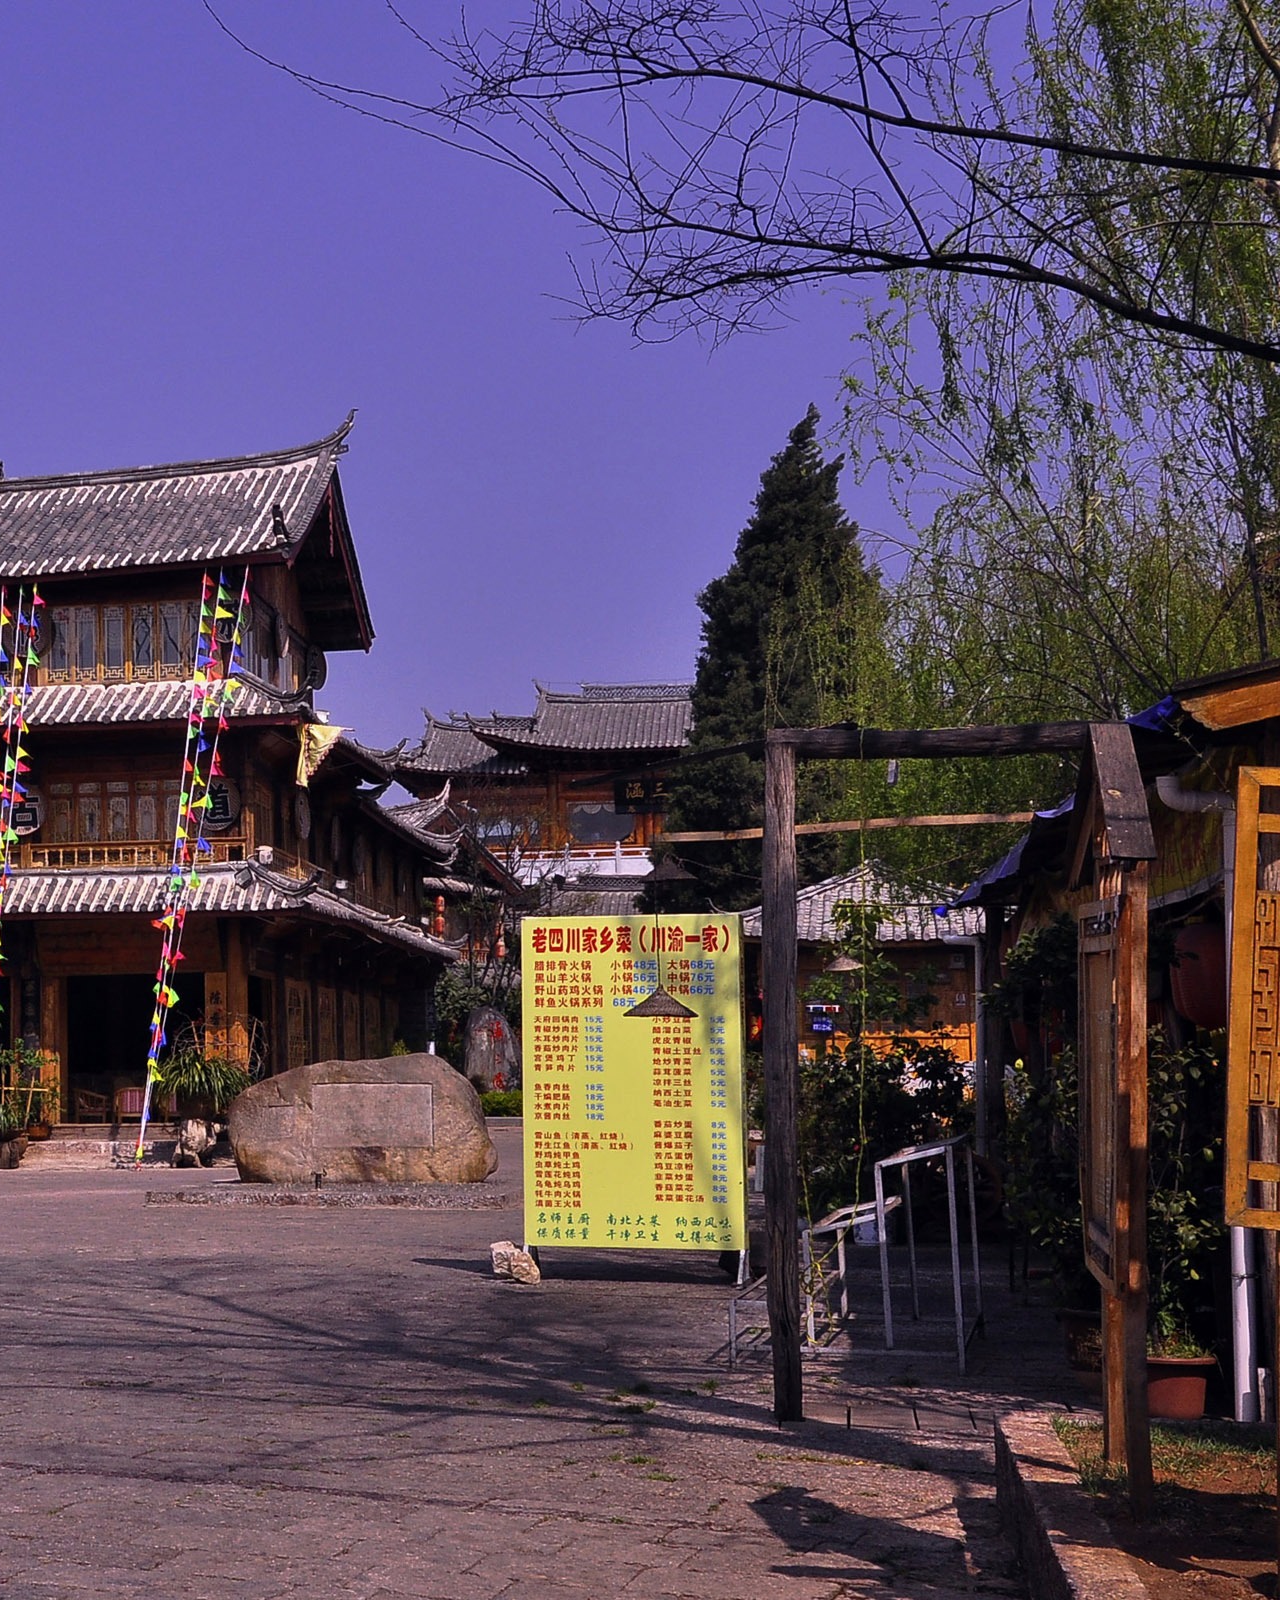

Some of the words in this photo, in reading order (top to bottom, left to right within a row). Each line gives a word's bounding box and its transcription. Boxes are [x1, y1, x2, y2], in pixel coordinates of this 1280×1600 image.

[534, 961, 591, 971] 腊排骨火锅
[611, 960, 657, 970] 小锅48元
[667, 960, 714, 970] 大锅68元
[535, 973, 591, 983] 黑山羊火锅
[611, 972, 657, 982] 小锅56元
[667, 972, 714, 982] 中锅76元
[534, 985, 603, 995] 野山药鸡火锅
[611, 985, 655, 995] 小锅46元
[667, 985, 714, 995] 中锅66元
[535, 997, 603, 1008] 鲜鱼火锅系列
[613, 998, 636, 1008] 68元
[585, 1016, 604, 1024] 15元
[710, 1016, 726, 1024] 5元
[534, 1025, 578, 1033] 青椒炒肉丝
[585, 1026, 604, 1034] 15元
[710, 1027, 726, 1035] 5元
[585, 1035, 604, 1044] 15元
[711, 1037, 726, 1045] 5元
[585, 1045, 604, 1053] 15元
[653, 1047, 701, 1055] 青椒土豆丝
[710, 1048, 726, 1056] 5元
[585, 1054, 604, 1062] 15元
[711, 1058, 726, 1066] 5元
[585, 1064, 604, 1072] 15元
[711, 1069, 726, 1077] 5元
[711, 1079, 726, 1087] 5元
[535, 1083, 569, 1091] 鱼香肉丝
[585, 1084, 605, 1092] 18元
[585, 1093, 605, 1102] 18元
[711, 1090, 727, 1098] 5元
[586, 1103, 605, 1111] 18元
[711, 1101, 727, 1109] 5元
[586, 1113, 605, 1121] 18元
[654, 1120, 692, 1128] 番茄炒蛋
[711, 1122, 727, 1130] 8元
[654, 1131, 692, 1139] 麻婆豆腐
[712, 1133, 727, 1141] 8元
[712, 1143, 728, 1151] 8元
[712, 1153, 728, 1162] 8元
[712, 1164, 728, 1172] 8元
[713, 1174, 728, 1183] 8元
[713, 1185, 728, 1193] 8元
[713, 1195, 729, 1204] 8元
[606, 1230, 659, 1242] 干净卫生
